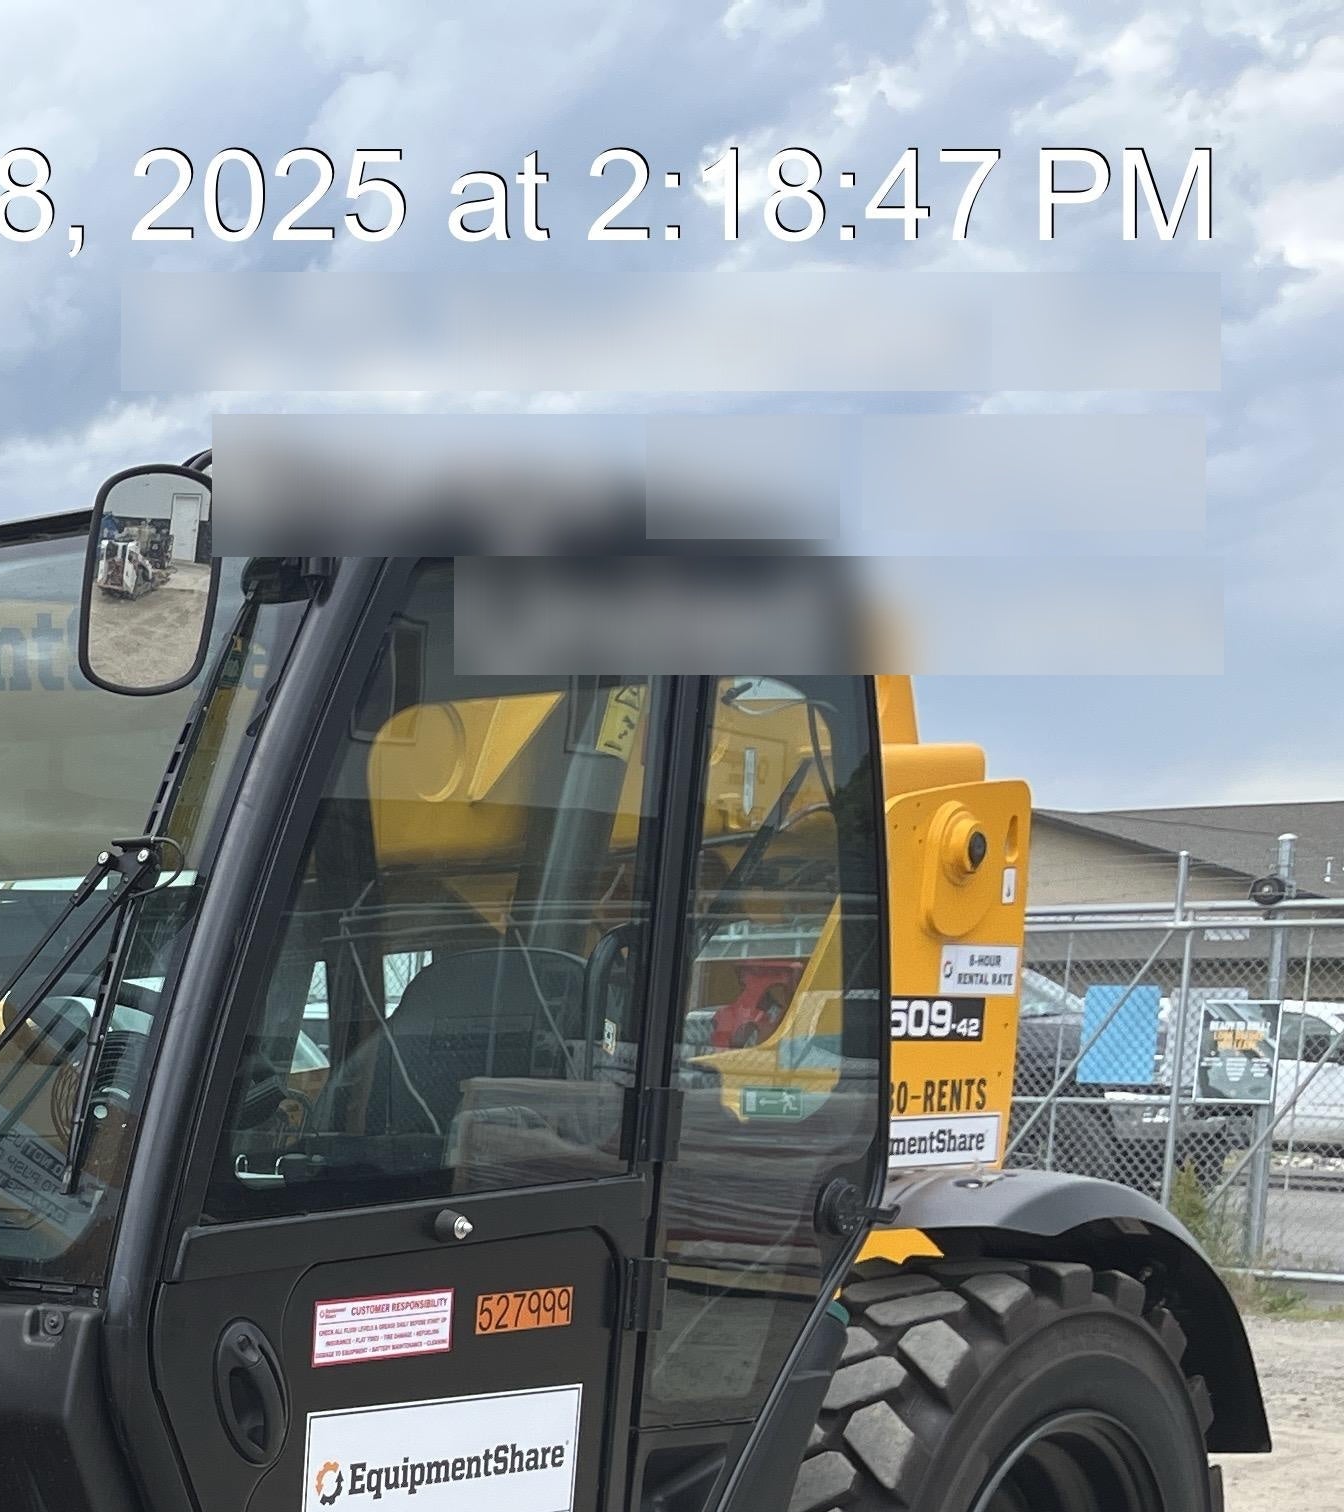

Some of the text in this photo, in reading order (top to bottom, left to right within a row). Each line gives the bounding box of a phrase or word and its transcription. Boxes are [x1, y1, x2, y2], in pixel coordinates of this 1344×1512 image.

[957, 972, 1013, 987] RENTAL RATE
[350, 1297, 448, 1317] CUSTOMER RESPONSIBILITY
[478, 1287, 571, 1332] 527999
[348, 1443, 565, 1500] EquipmentShare
